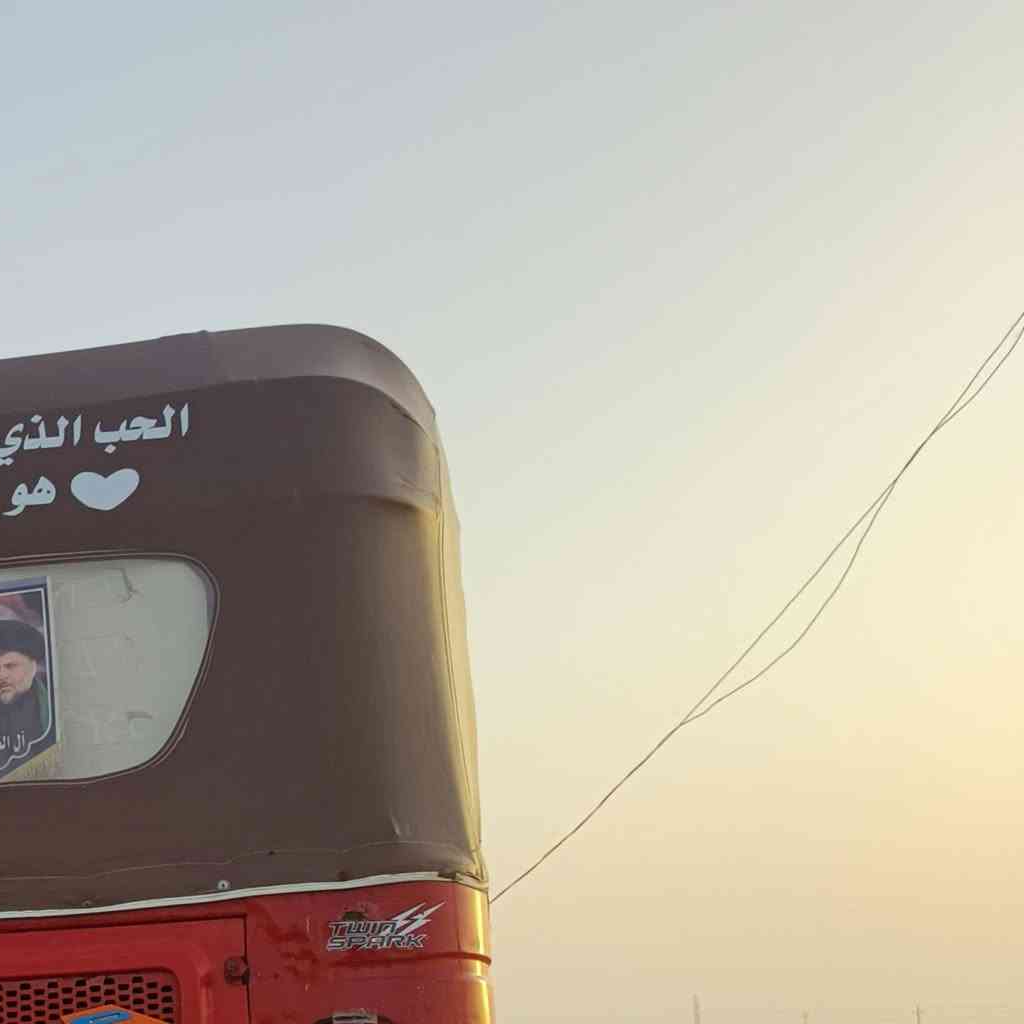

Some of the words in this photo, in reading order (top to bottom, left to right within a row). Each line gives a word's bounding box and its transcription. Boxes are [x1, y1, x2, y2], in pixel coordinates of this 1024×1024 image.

[94, 403, 190, 454] الحب
[3, 475, 57, 517] هو
[327, 934, 427, 950] SPARK
[328, 920, 397, 936] TWIN
